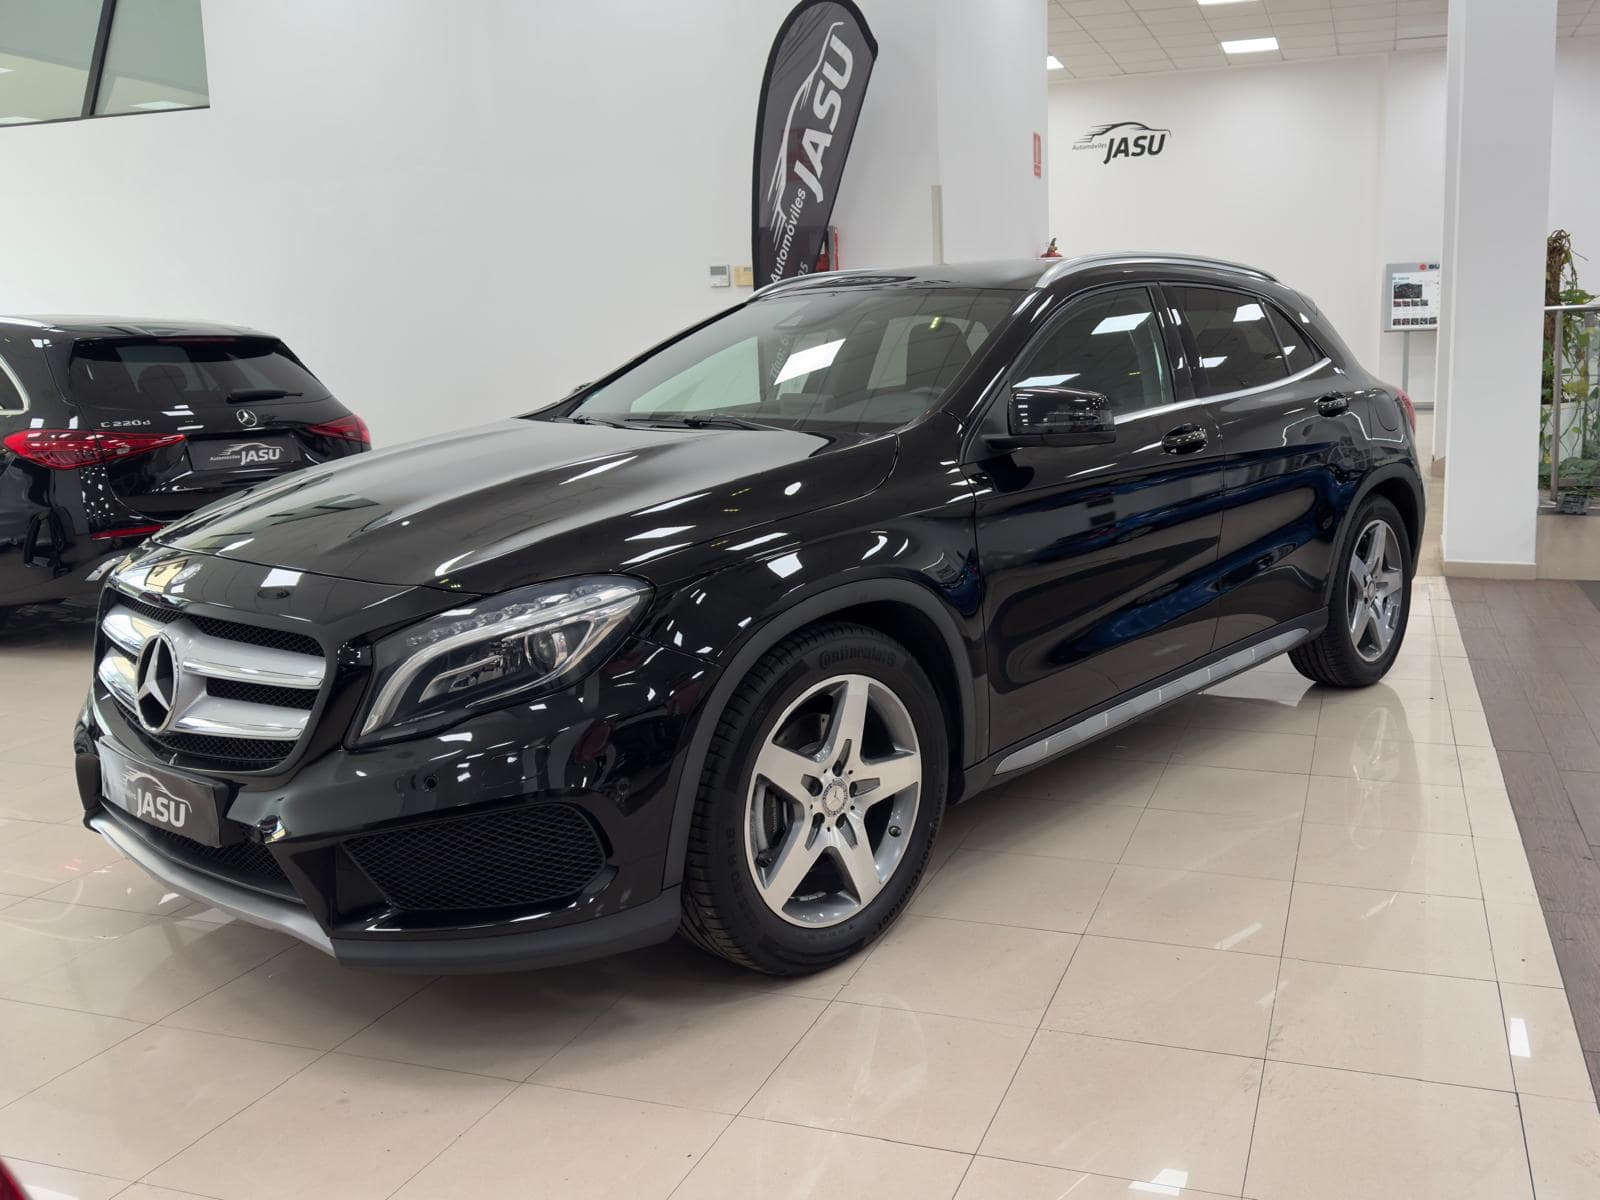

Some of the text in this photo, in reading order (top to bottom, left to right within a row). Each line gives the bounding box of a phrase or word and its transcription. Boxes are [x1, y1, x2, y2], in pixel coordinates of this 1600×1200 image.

[770, 188, 807, 284] Automóviles
[794, 34, 853, 203] JASU
[1103, 134, 1166, 164] JASU
[240, 449, 280, 465] JASU
[136, 788, 186, 828] JASU
